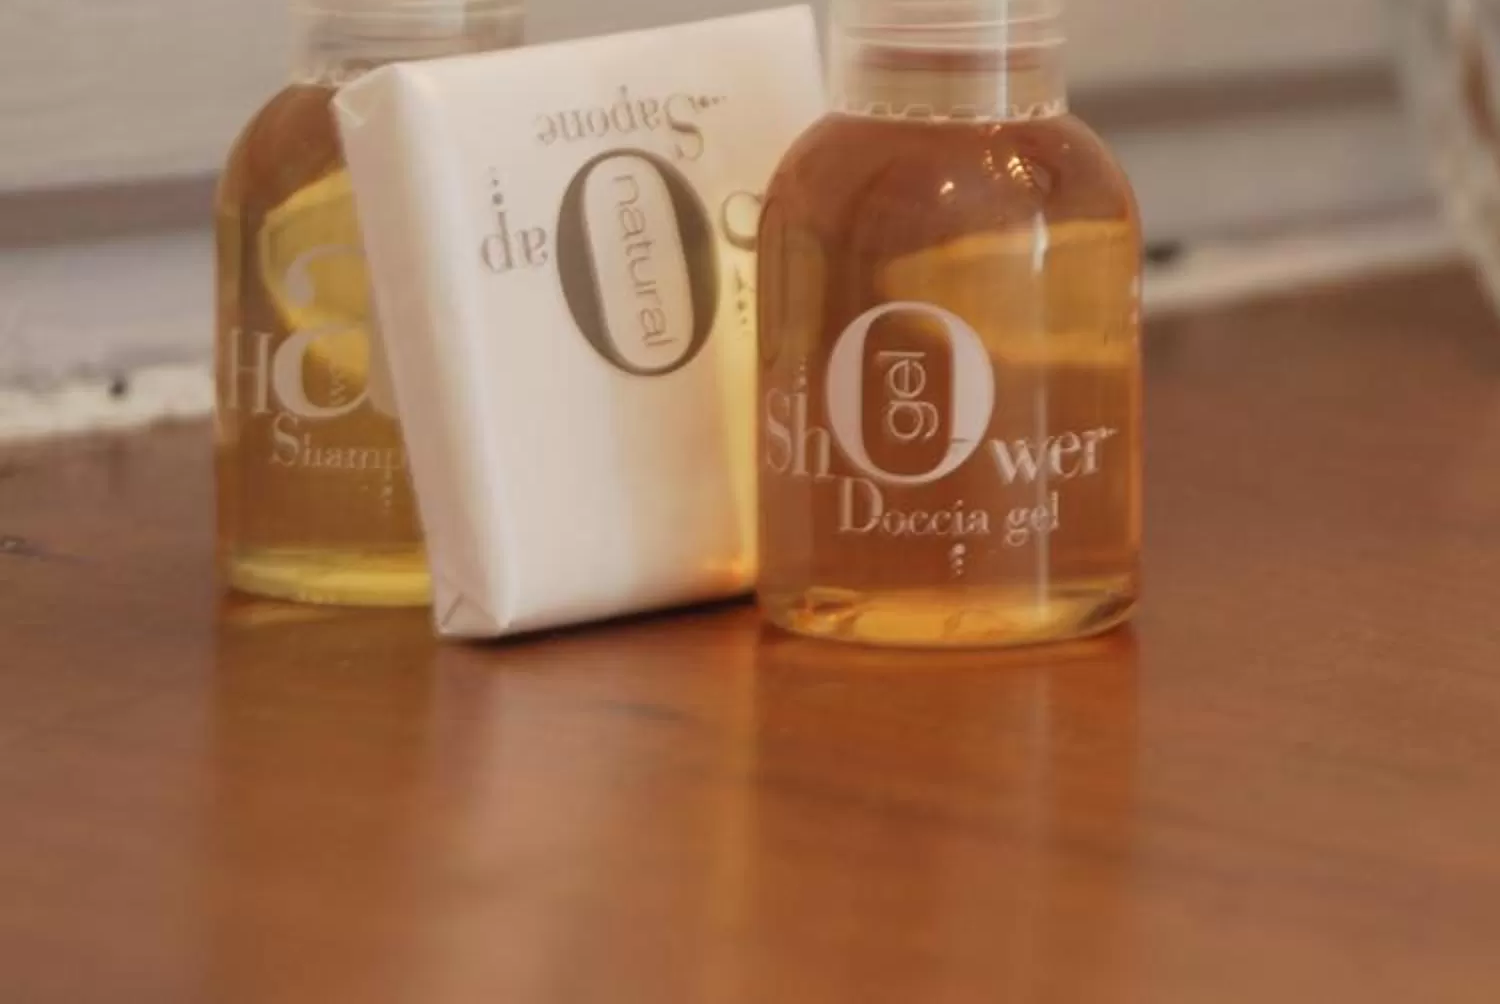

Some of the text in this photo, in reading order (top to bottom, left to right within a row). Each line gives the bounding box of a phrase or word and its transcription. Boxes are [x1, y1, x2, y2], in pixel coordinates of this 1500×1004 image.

[534, 90, 706, 161] Sapone
[612, 174, 680, 347] natural
[879, 350, 939, 441] gel
[839, 477, 1061, 547] Doccia gel
